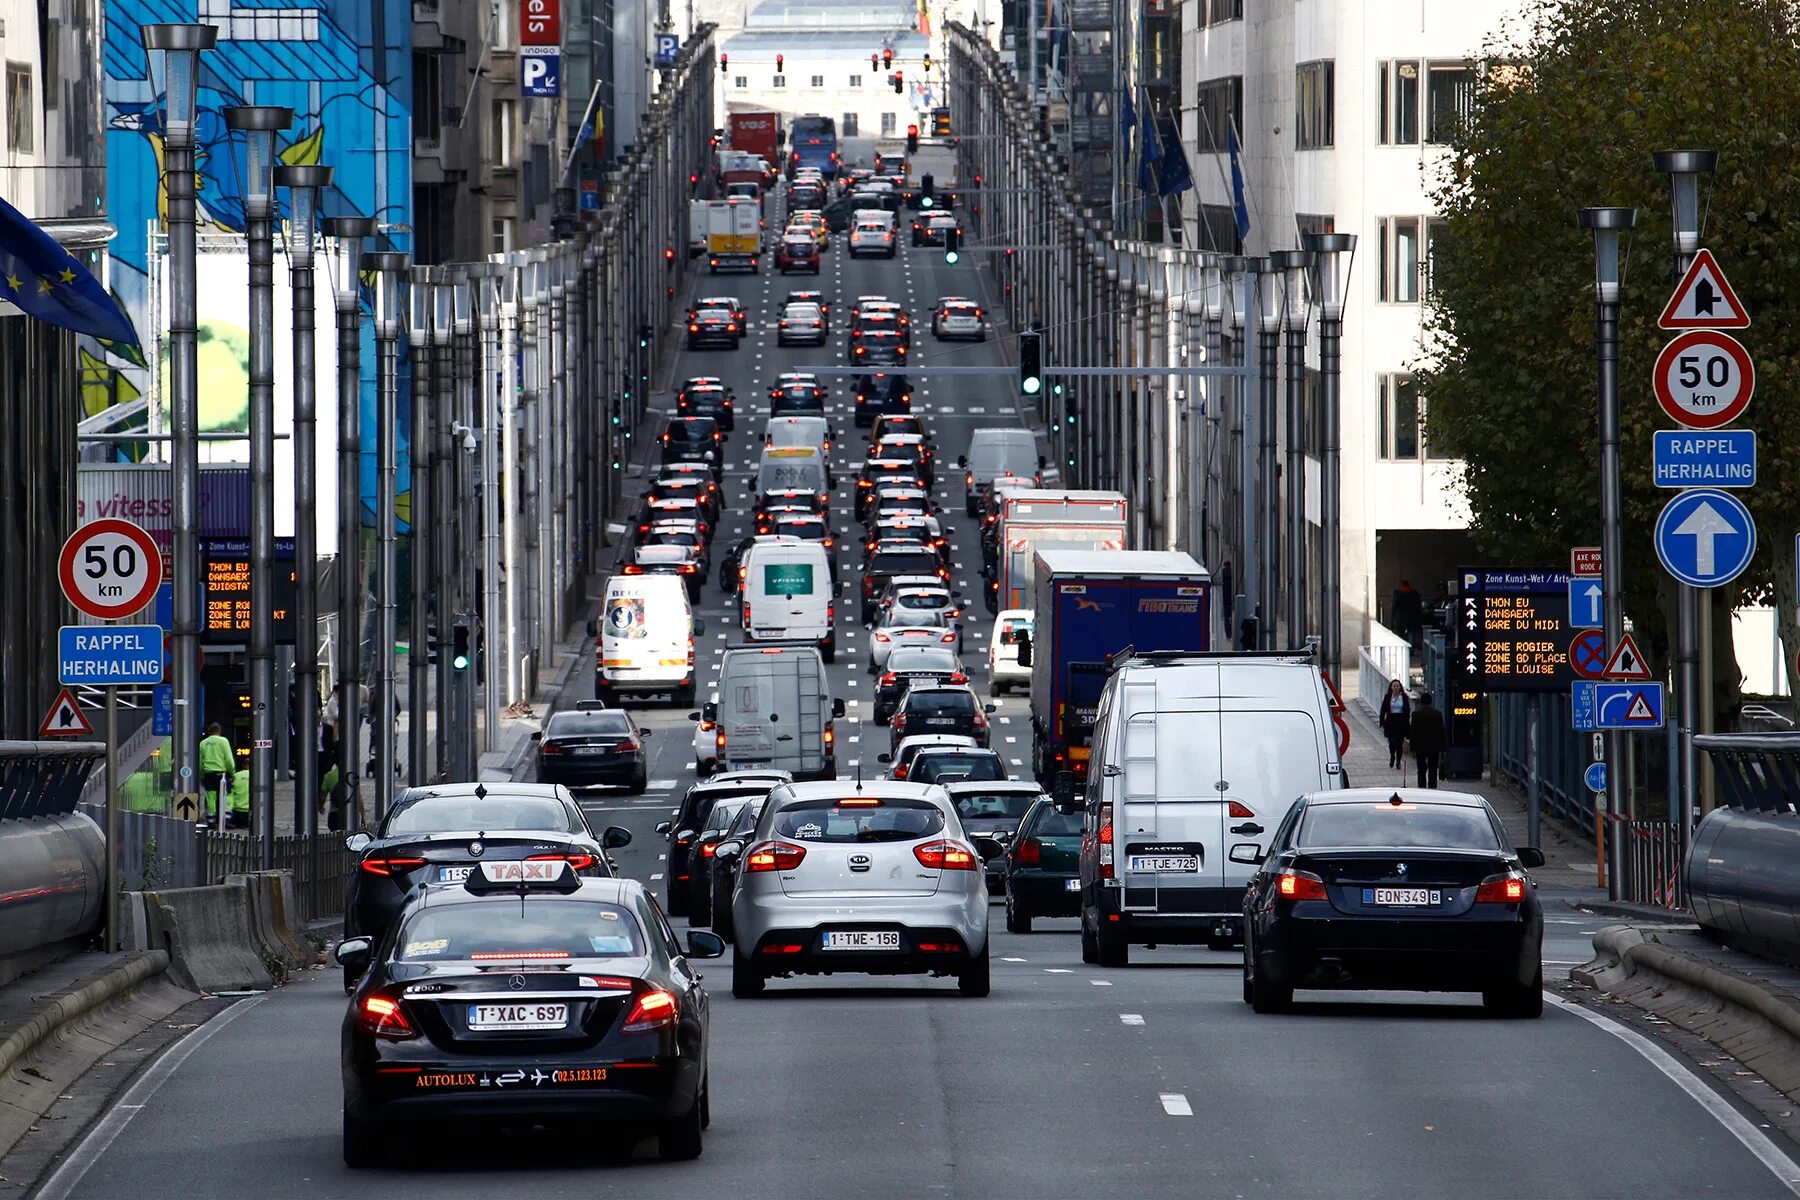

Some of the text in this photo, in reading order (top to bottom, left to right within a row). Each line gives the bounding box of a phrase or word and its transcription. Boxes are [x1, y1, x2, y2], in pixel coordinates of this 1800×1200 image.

[528, 0, 551, 32] els
[524, 58, 547, 87] P
[1680, 356, 1729, 388] 50
[1692, 392, 1716, 406] km
[1671, 440, 1738, 454] RAPPEL
[1658, 464, 1752, 478] HERHALING
[96, 493, 172, 518] vitess
[209, 542, 225, 550] Zone
[226, 542, 250, 550] Kunst-
[85, 545, 136, 578] 50
[209, 563, 248, 571] THON EU
[1485, 573, 1503, 583] Zone
[1505, 573, 1546, 583] Kunst-Wet
[1554, 573, 1570, 583] Arts
[98, 583, 123, 597] km
[209, 602, 231, 610] ZONE
[1485, 597, 1529, 607] THON EU
[209, 611, 231, 619] ZONE
[1485, 609, 1535, 618] DANSAERT
[209, 620, 231, 629] ZONE
[1485, 620, 1560, 630] GARE DU MIDI
[76, 635, 144, 650] RAPPEL
[1485, 642, 1555, 652] ZONE ROGIER
[1485, 653, 1567, 663] ZONE GD PLACE
[63, 660, 159, 675] HERHALING
[1485, 664, 1555, 674] ZONE LOUISE
[1584, 709, 1591, 717] 7
[1583, 720, 1593, 728] 13
[447, 868, 473, 881] 1-S
[490, 864, 553, 879] TAXI
[831, 933, 898, 945] 1-TWE-158
[478, 1006, 566, 1022] T-XAC-697
[416, 1069, 607, 1087] AUTOLUX 02.5.123.123
